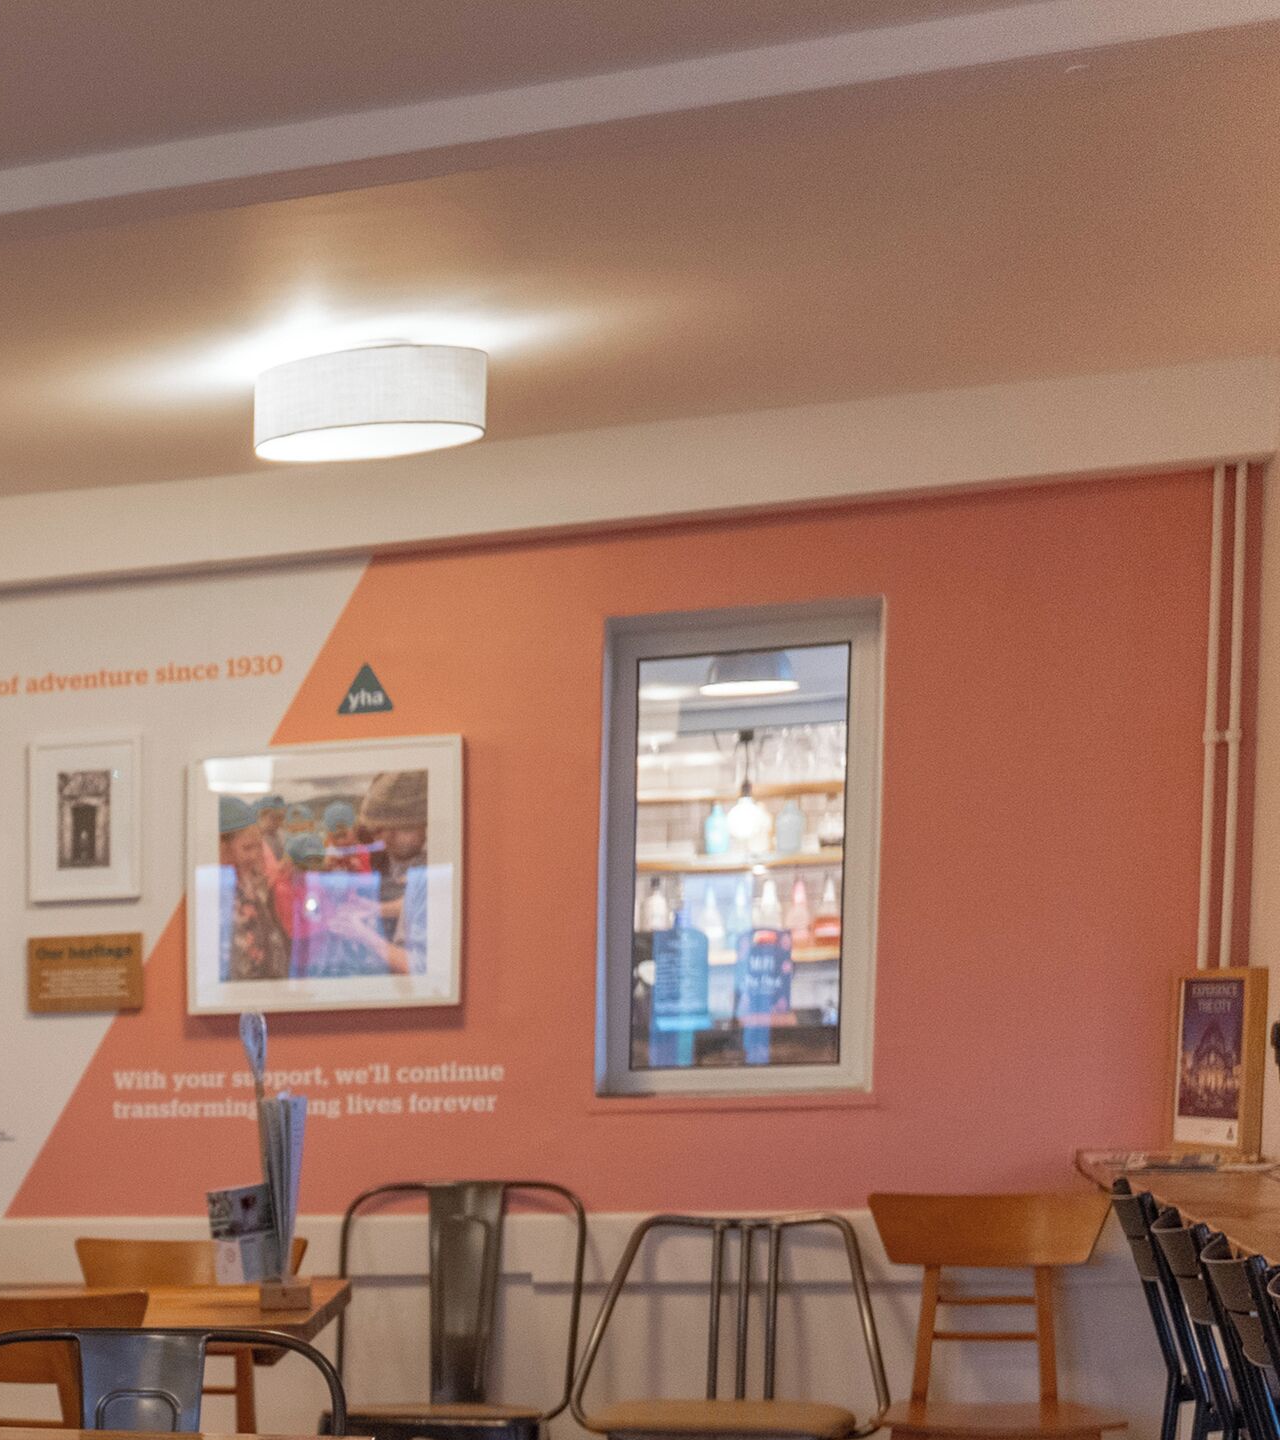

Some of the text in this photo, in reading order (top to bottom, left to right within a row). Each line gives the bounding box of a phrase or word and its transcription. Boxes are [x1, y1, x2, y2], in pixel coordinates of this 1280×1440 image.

[26, 667, 148, 695] adventure
[155, 660, 220, 684] since
[226, 654, 284, 679] 1930
[348, 688, 384, 712] yha
[112, 1069, 167, 1090] With
[172, 1071, 225, 1092] your
[335, 1063, 390, 1085] we'll
[395, 1061, 505, 1084] continue
[112, 1097, 258, 1121] transforming
[346, 1093, 403, 1115] lives
[409, 1091, 498, 1113] forever
